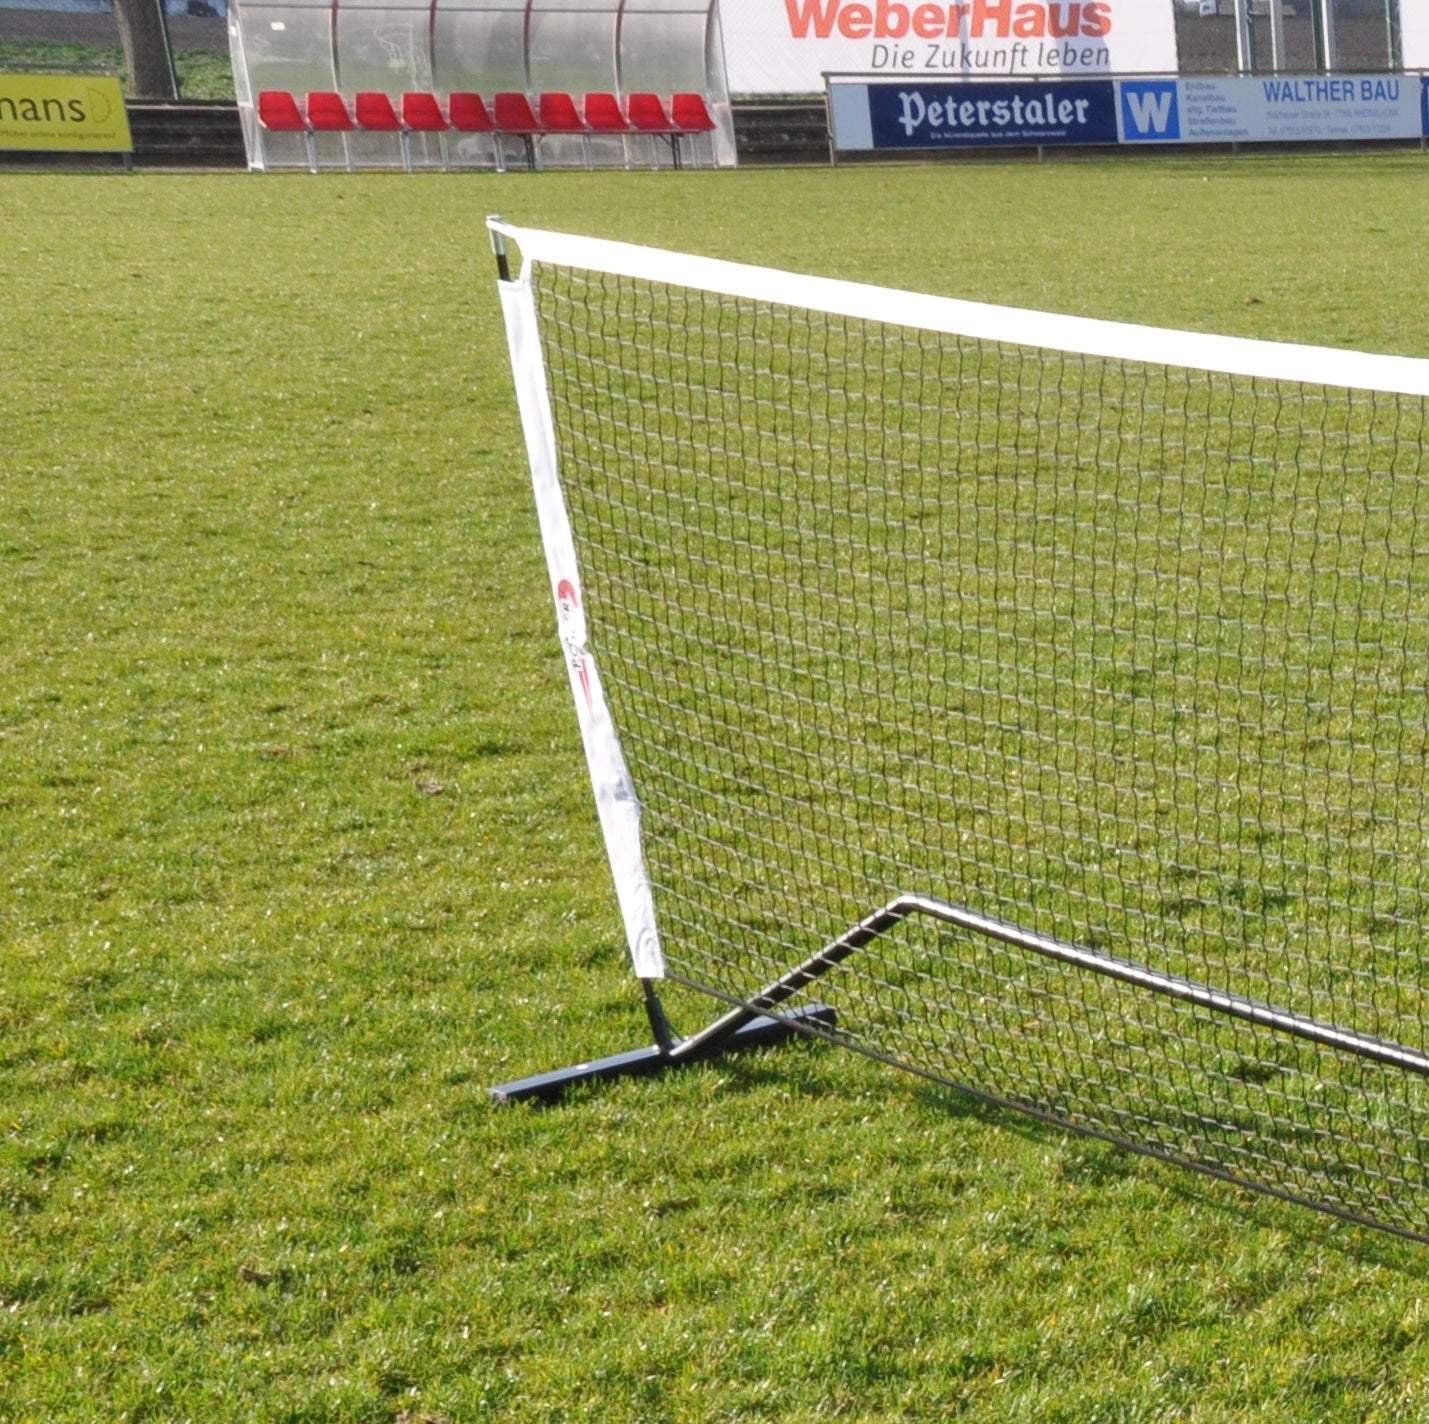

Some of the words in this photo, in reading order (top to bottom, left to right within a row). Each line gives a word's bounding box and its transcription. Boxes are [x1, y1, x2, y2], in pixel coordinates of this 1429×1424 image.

[784, 0, 1112, 39] WeberHaus
[871, 44, 915, 69] Die
[925, 41, 1029, 73] Zukunft
[1037, 41, 1110, 67] leben
[1263, 80, 1355, 102] WALTHER
[1360, 79, 1399, 101] BAU
[899, 91, 1090, 136] Peterstaler
[1126, 91, 1172, 133] W
